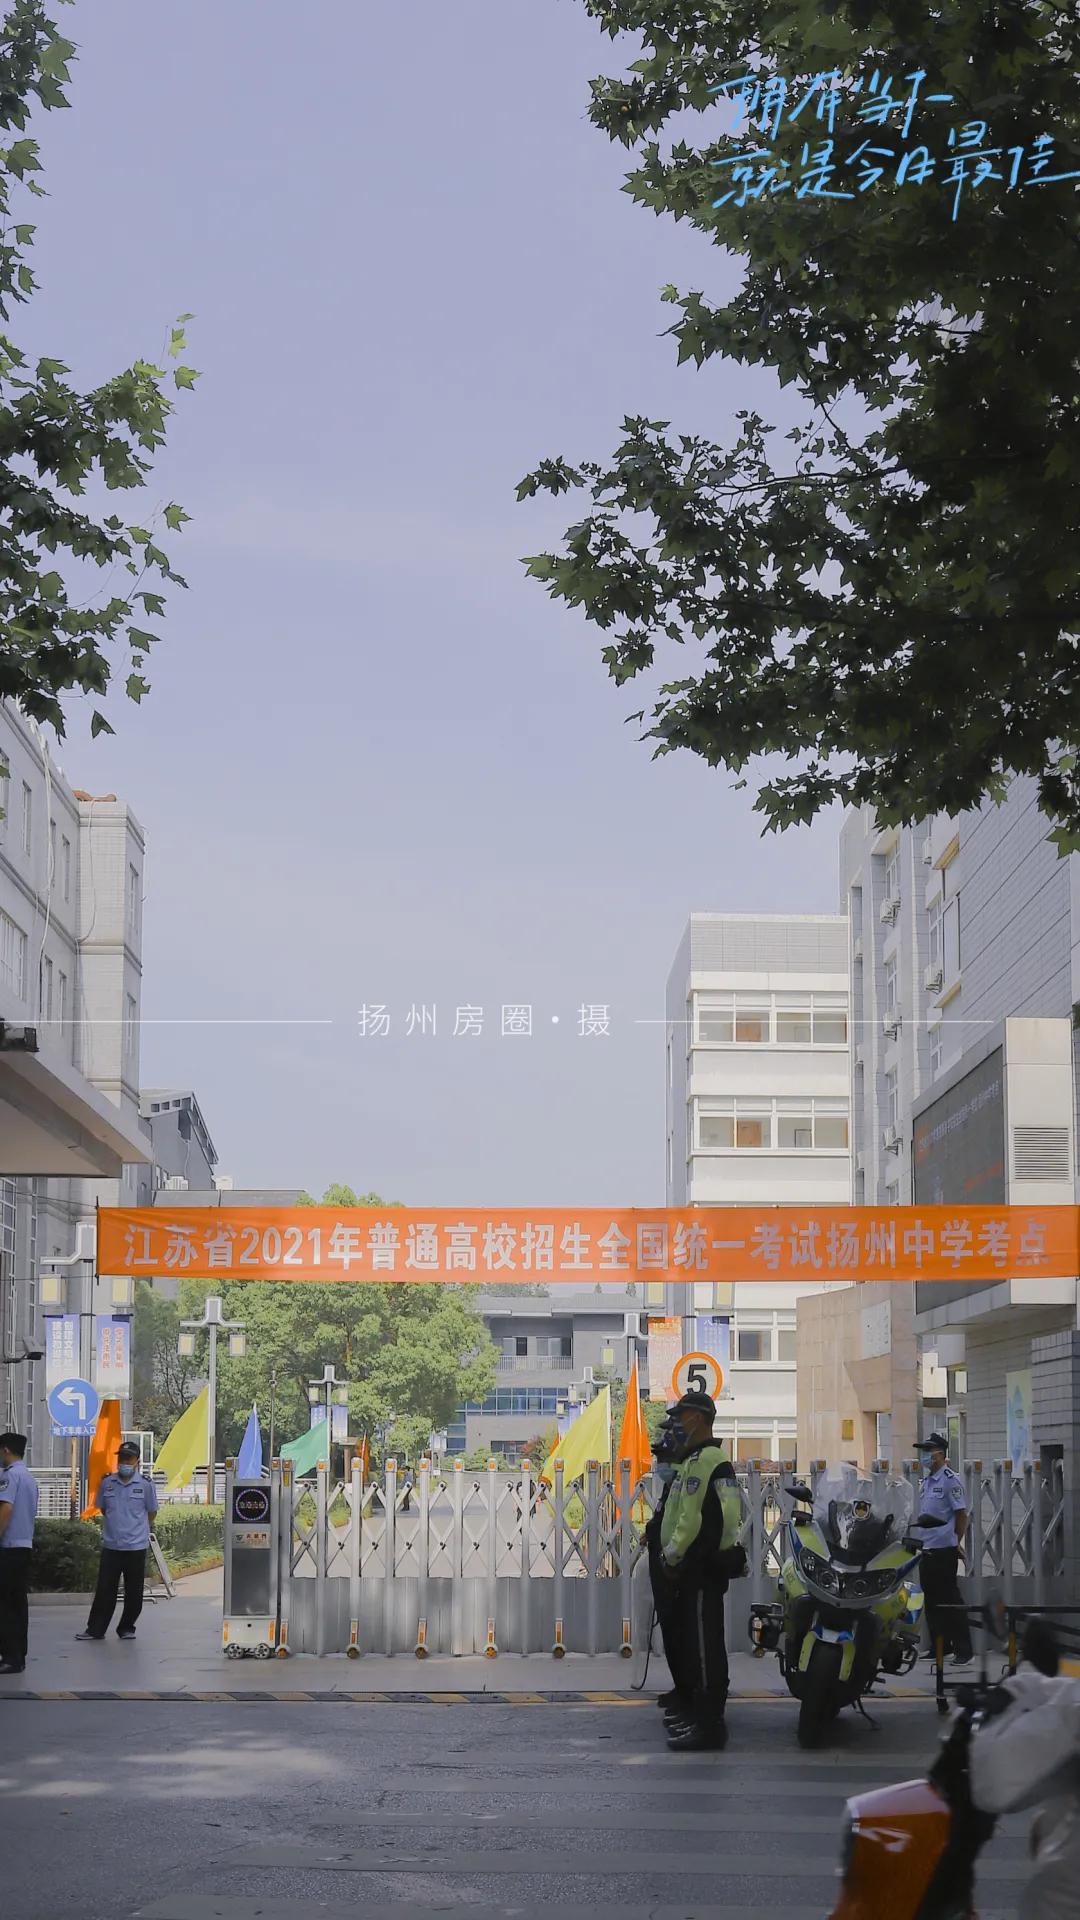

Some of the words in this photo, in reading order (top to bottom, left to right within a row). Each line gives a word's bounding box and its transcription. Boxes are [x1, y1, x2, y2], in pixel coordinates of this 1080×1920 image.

[123, 1218, 1050, 1271] 江苏省2021年普通高校招生全国统一考试扬州中学考点
[686, 1364, 707, 1394] 5
